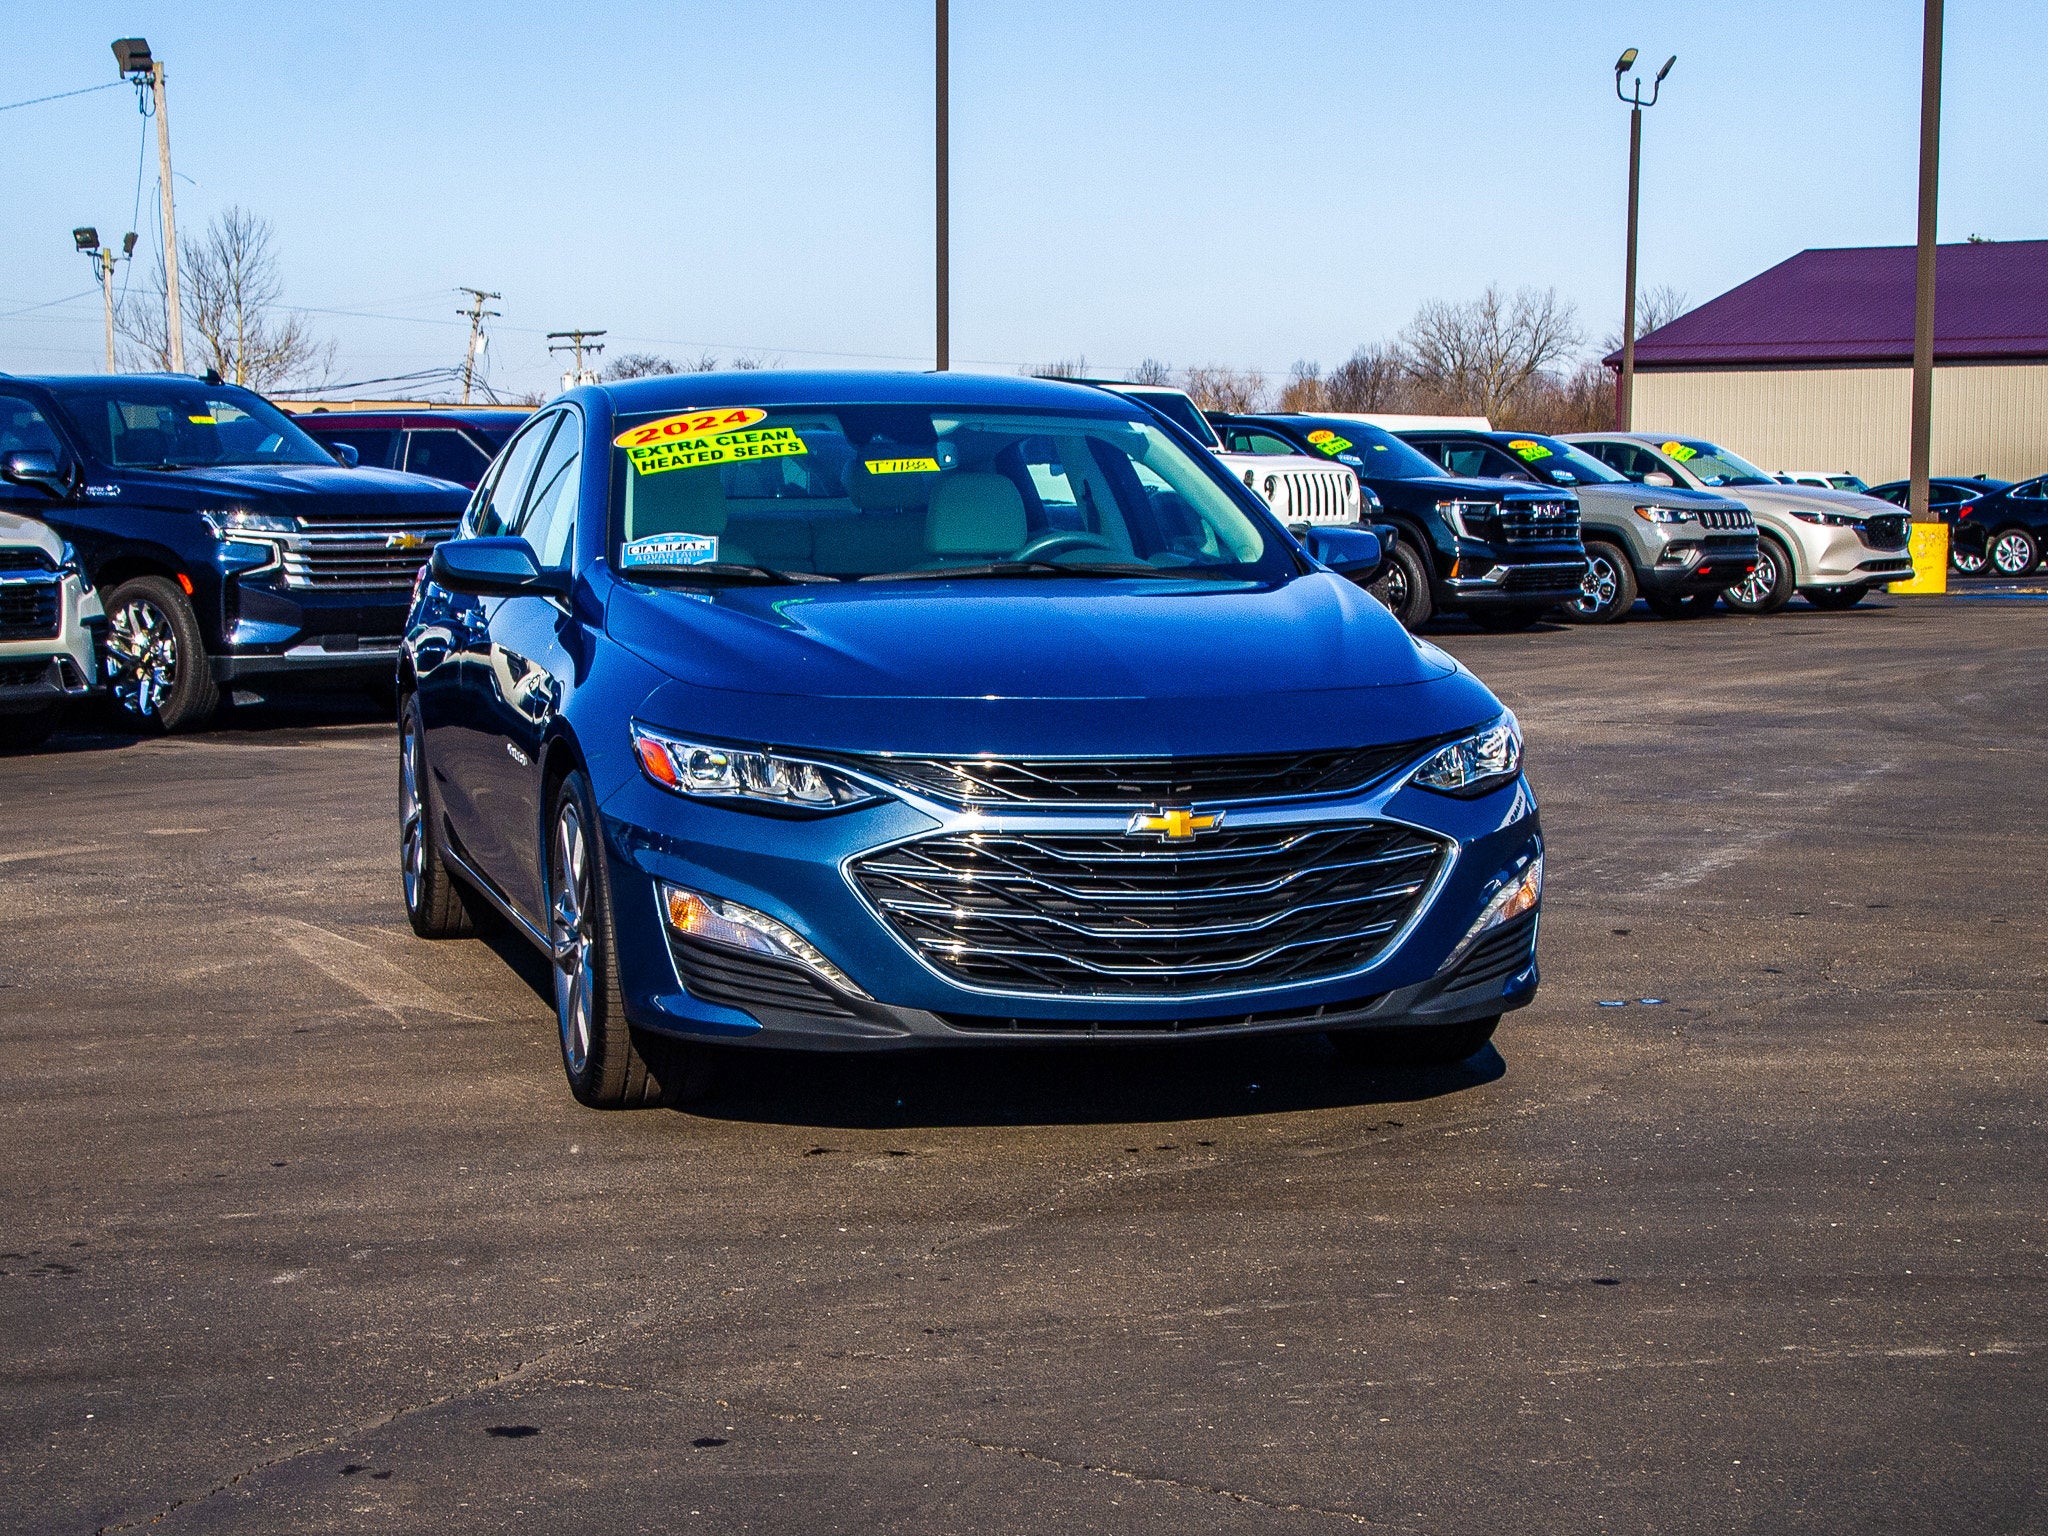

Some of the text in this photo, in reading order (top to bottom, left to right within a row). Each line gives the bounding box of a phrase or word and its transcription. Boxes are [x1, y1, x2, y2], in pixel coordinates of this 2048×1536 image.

[634, 410, 750, 445] 2024
[632, 430, 788, 460] EXTRA CLEAN
[641, 441, 801, 471] HEATED SEATS
